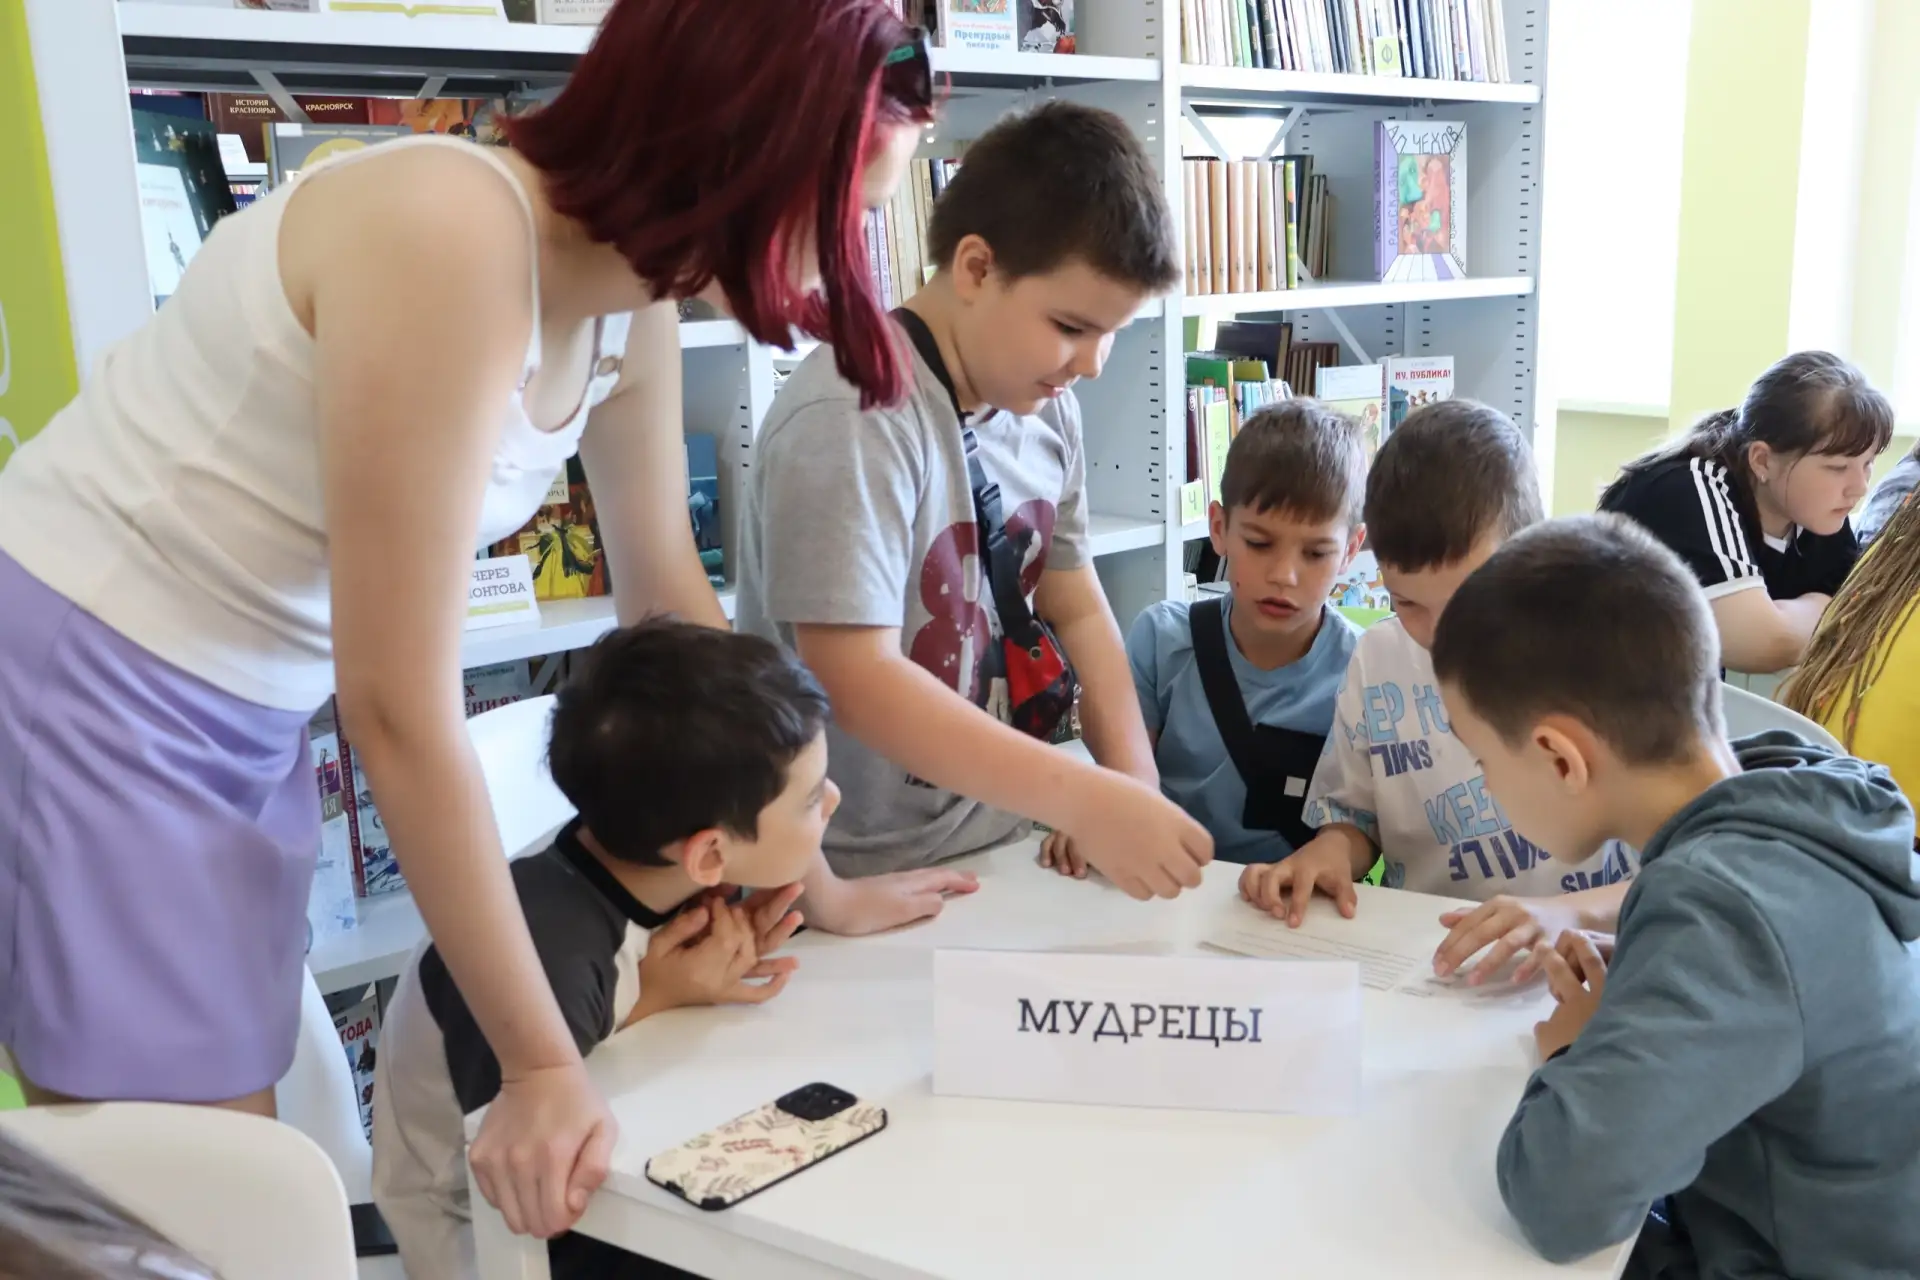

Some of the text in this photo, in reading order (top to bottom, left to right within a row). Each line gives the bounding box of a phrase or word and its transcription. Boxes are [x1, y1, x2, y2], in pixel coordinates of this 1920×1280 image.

[1381, 43, 1393, 64] Ф
[229, 106, 277, 114] КРАСНОЯРЬЯ
[235, 99, 269, 107] ИСТОРИЯ
[305, 103, 354, 112] КРАСНОЯРСК
[1412, 126, 1459, 155] ЧЕХОВ
[1410, 369, 1451, 379] ПУБЛИКА!
[472, 567, 510, 582] ЧЕРЕЗ
[1370, 739, 1434, 777] SMIL
[1448, 829, 1551, 881] MILE
[1017, 998, 1263, 1048] МУДРЕЦЫ
